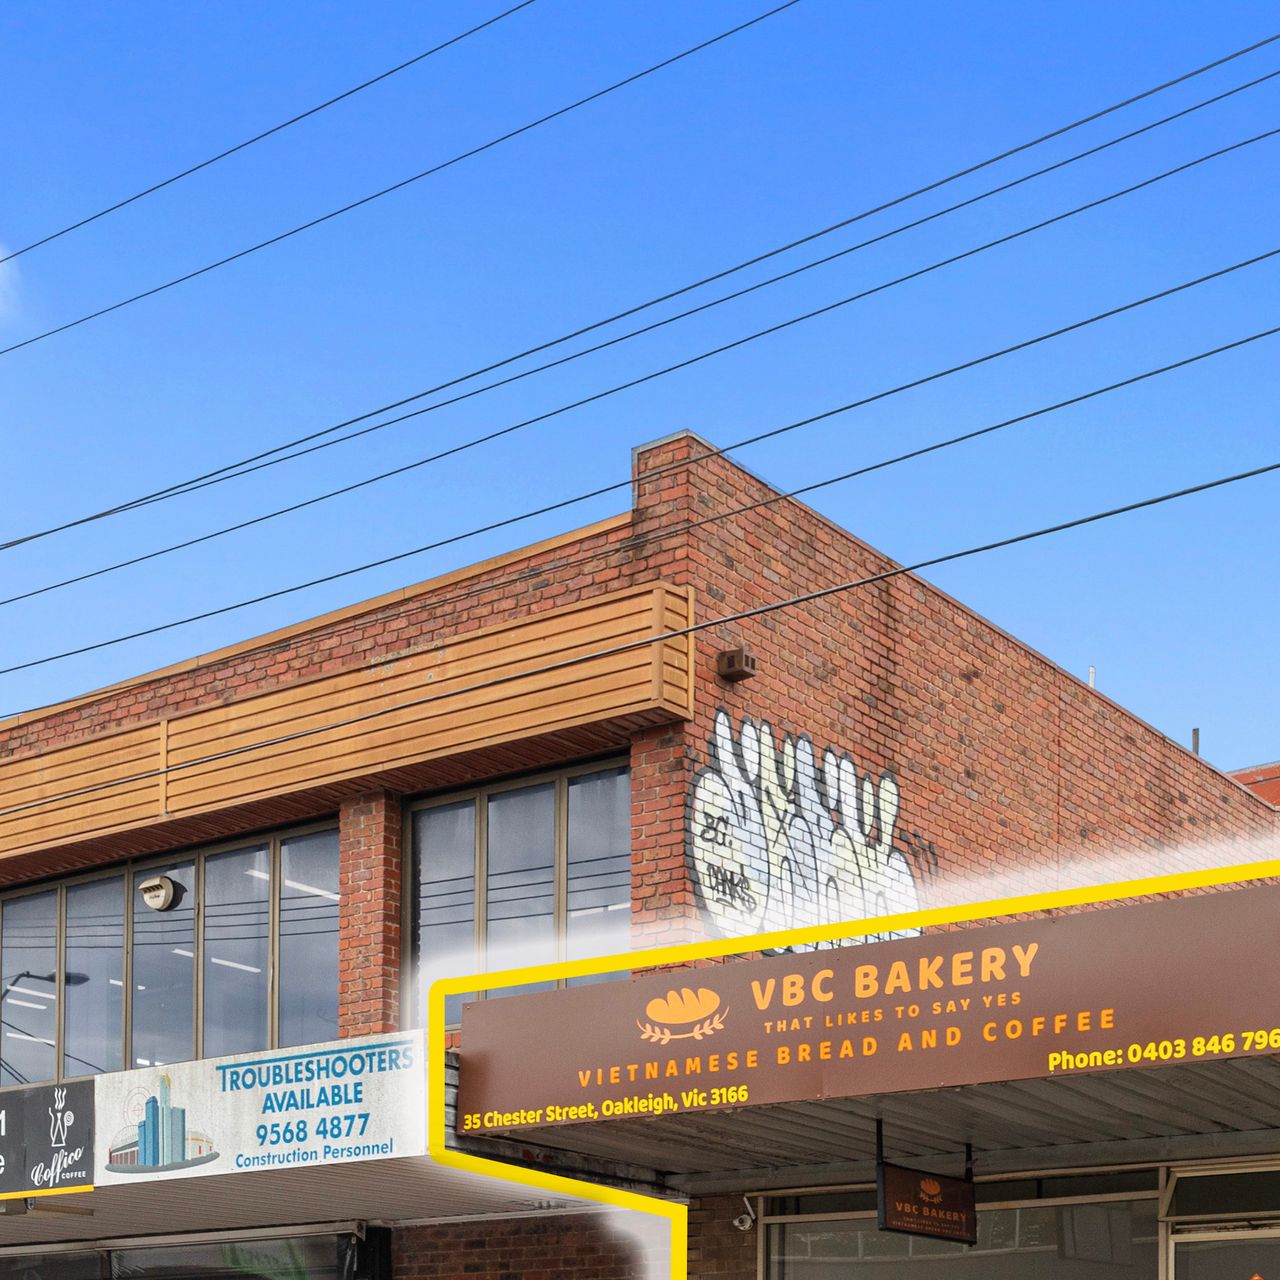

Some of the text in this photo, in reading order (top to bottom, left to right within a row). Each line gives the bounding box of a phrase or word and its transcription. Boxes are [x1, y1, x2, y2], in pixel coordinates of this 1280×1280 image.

[751, 942, 1039, 1010] VBC BAKERY
[764, 991, 1021, 1034] THAT LIKES TO SAY YES
[216, 1040, 414, 1092] TROUBLESHOOTERS
[578, 1008, 1115, 1088] VIETNAMESE BREAD AND COFFEE
[1048, 1048, 1123, 1071] Phone:
[1127, 1039, 1186, 1062] 0403
[1191, 1033, 1235, 1056] 846
[261, 1082, 363, 1114] AVAILABLE
[463, 1084, 748, 1130] 35 Chester Street, Oakleigh, Vic 3166
[256, 1113, 370, 1146] 9568 4877
[236, 1138, 393, 1168] Construction Personnel
[61, 1171, 86, 1179] COFFEE
[895, 1201, 967, 1221] VBC BAKERY
